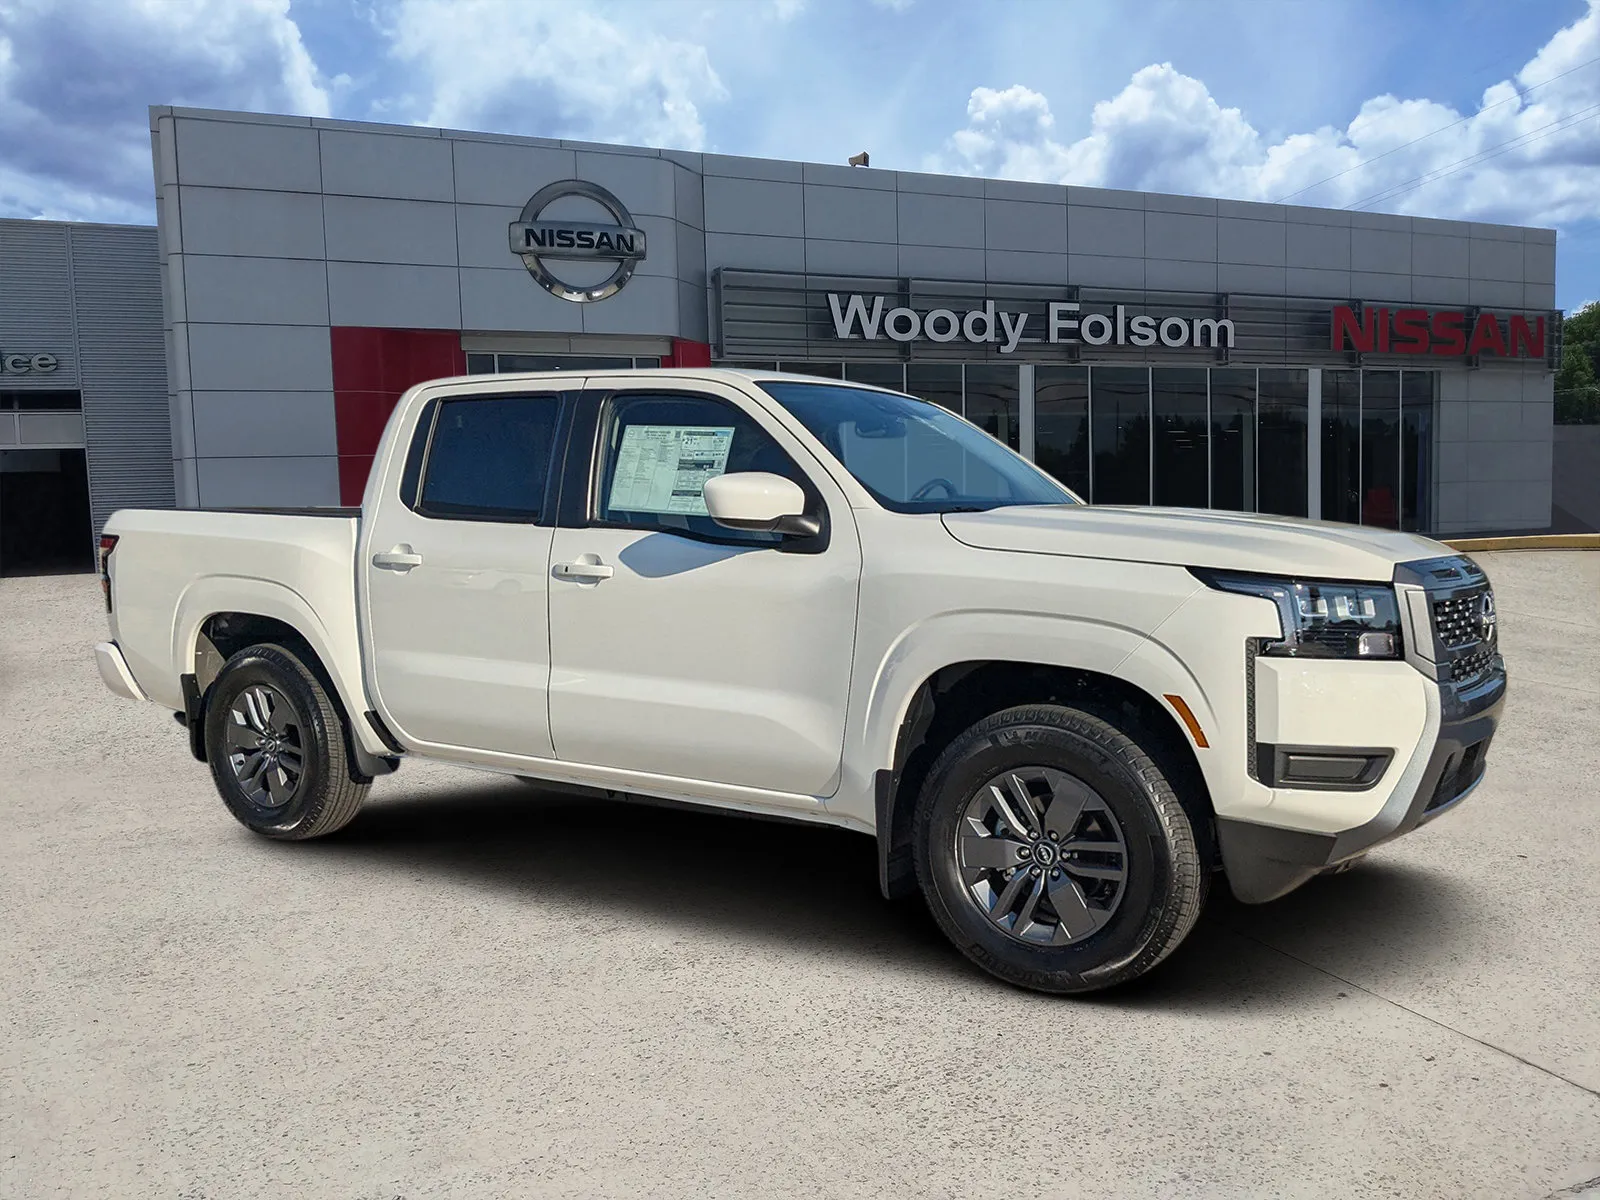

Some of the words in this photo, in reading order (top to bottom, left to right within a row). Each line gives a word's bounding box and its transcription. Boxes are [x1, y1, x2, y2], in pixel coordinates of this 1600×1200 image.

[525, 228, 635, 252] NISSAN
[826, 293, 1029, 353] Woody
[1048, 301, 1235, 348] Folsom
[1333, 305, 1545, 357] NISSAN
[0, 351, 57, 374] ce
